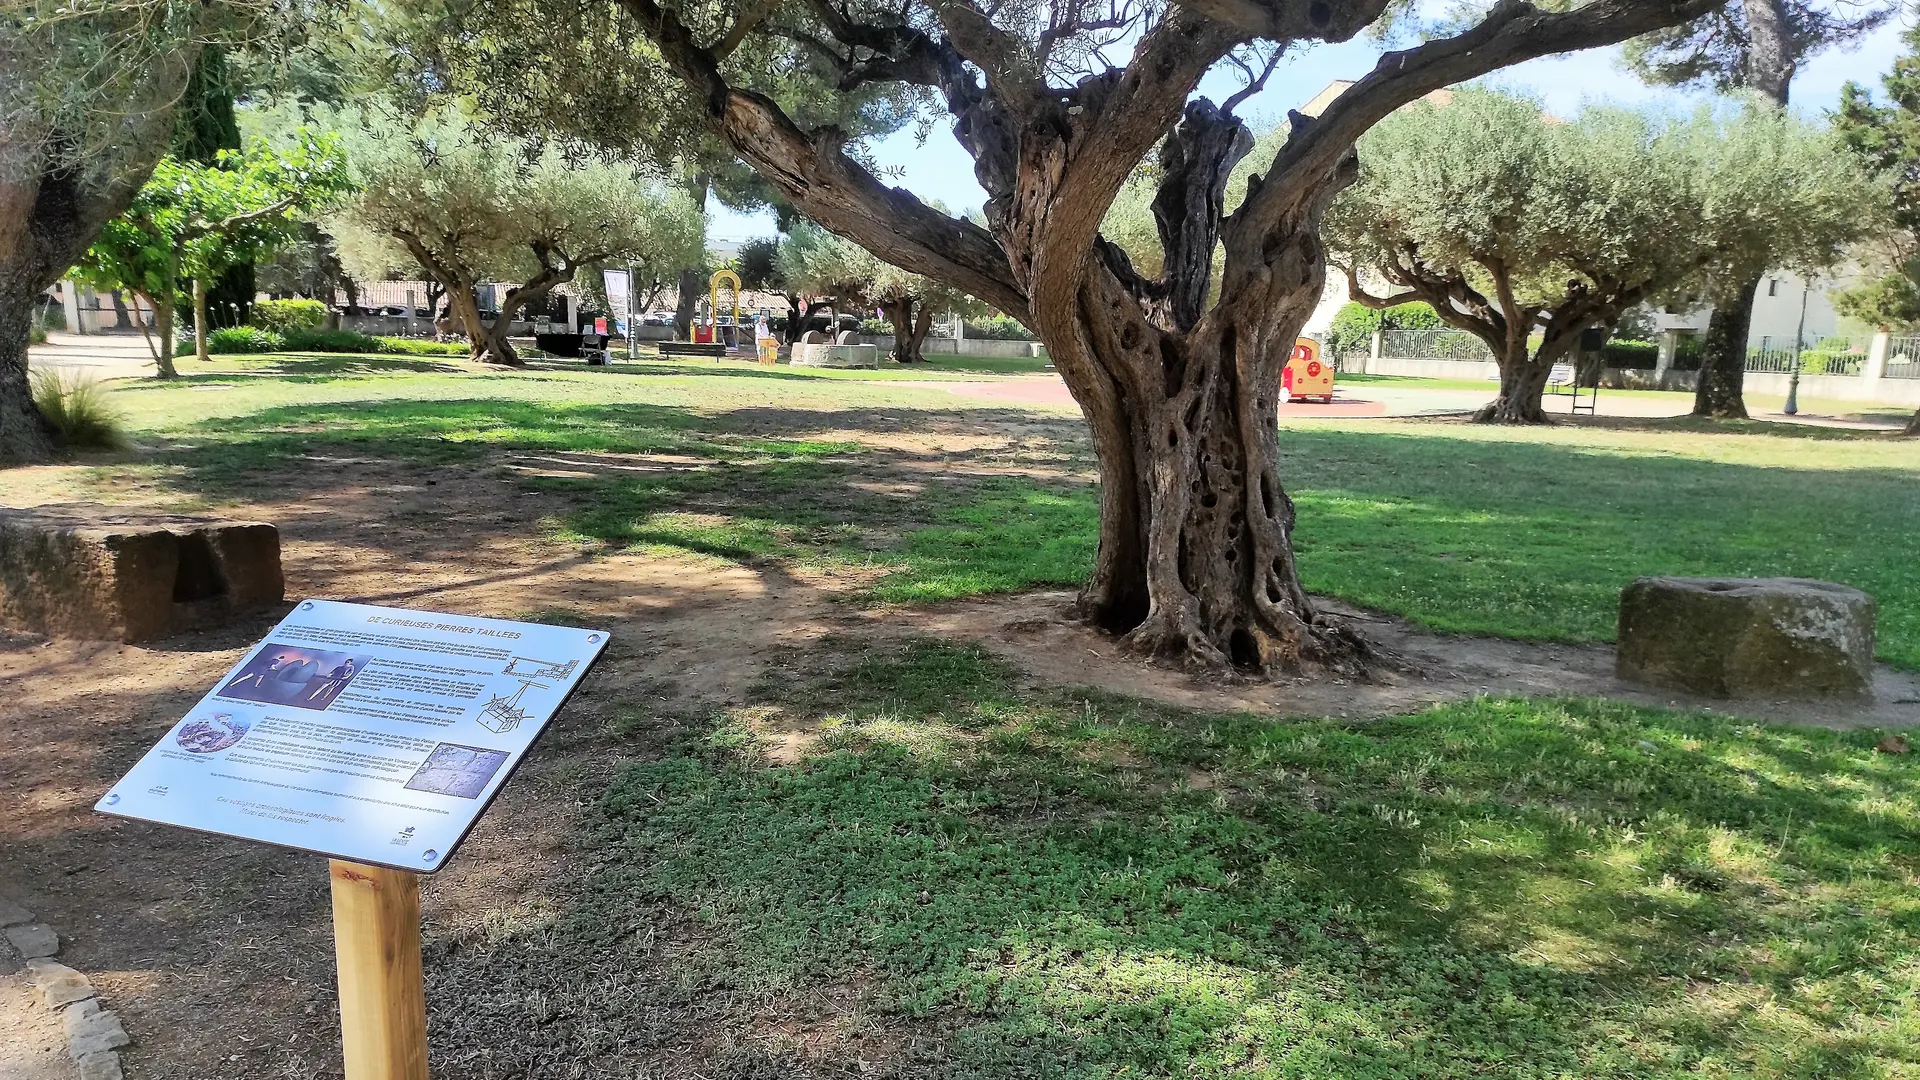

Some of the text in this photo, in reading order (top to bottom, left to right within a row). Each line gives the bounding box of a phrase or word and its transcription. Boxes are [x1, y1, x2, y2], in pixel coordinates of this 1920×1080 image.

[382, 617, 434, 629] CURIEUSES
[433, 623, 475, 634] PIERRES
[477, 628, 521, 640] TAILLEES
[304, 811, 321, 819] sont
